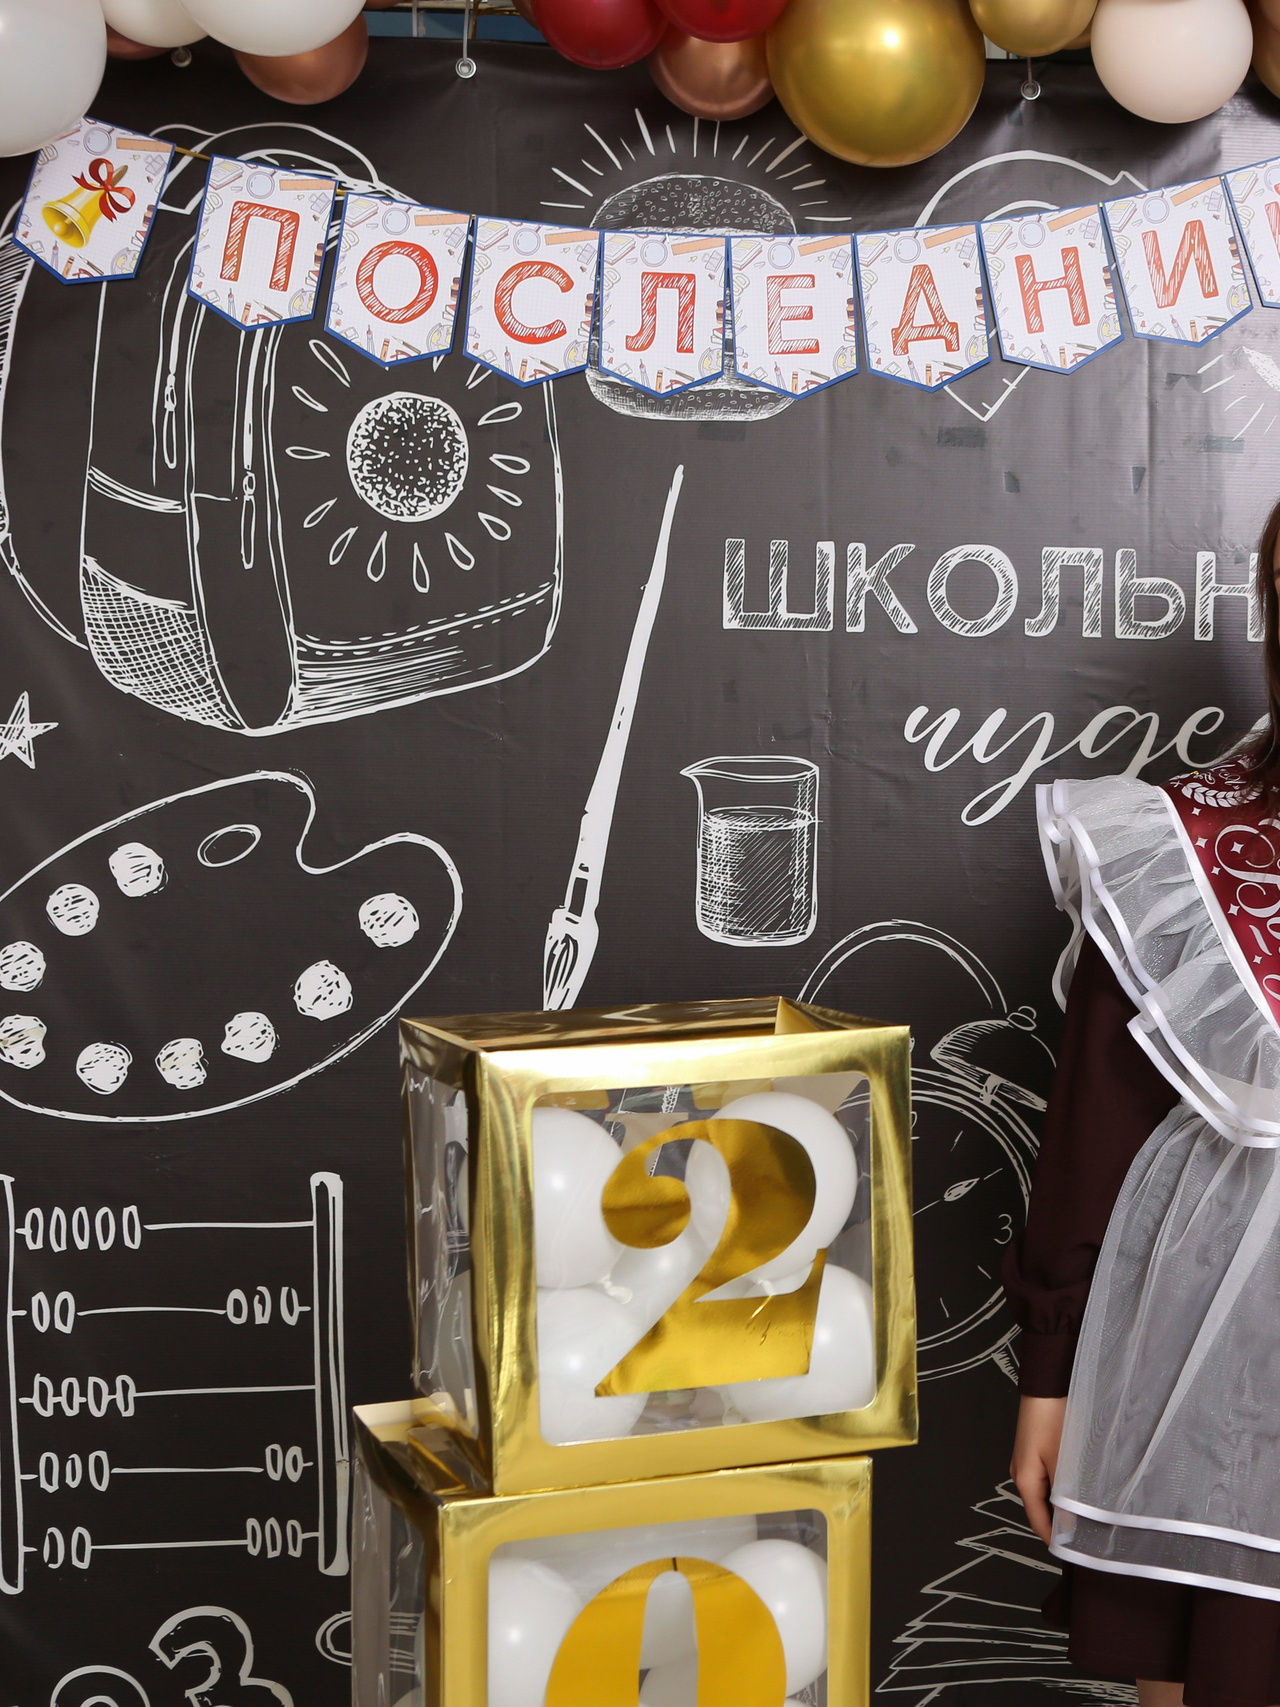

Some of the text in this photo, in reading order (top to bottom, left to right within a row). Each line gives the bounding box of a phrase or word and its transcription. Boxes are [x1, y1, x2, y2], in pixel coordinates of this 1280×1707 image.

[723, 538, 1266, 642] ШКОЛЬН
[904, 705, 1271, 826] чуде
[594, 1118, 828, 1398] 2
